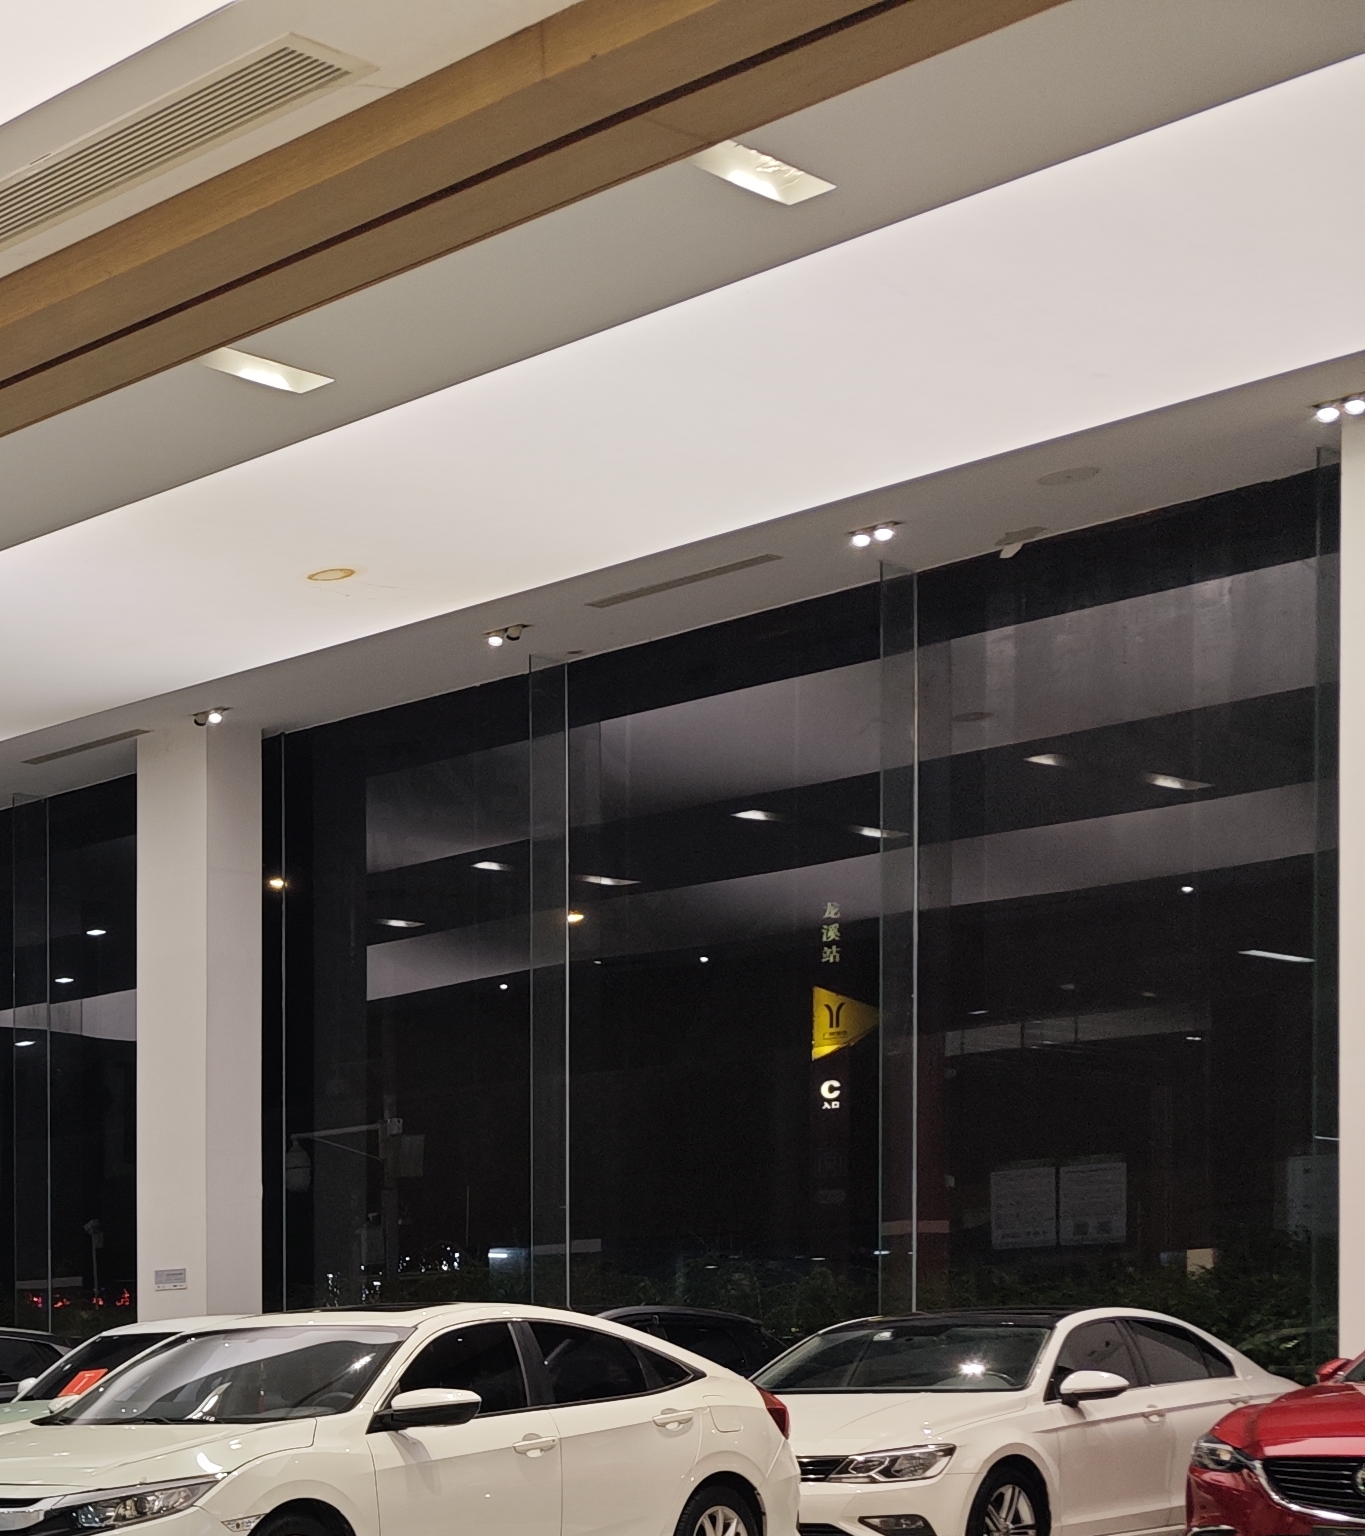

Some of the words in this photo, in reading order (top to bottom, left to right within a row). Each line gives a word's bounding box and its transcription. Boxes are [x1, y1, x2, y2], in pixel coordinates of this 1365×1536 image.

[821, 901, 842, 964] 龙溪站
[820, 1079, 841, 1100] C
[821, 1100, 841, 1109] 入口
